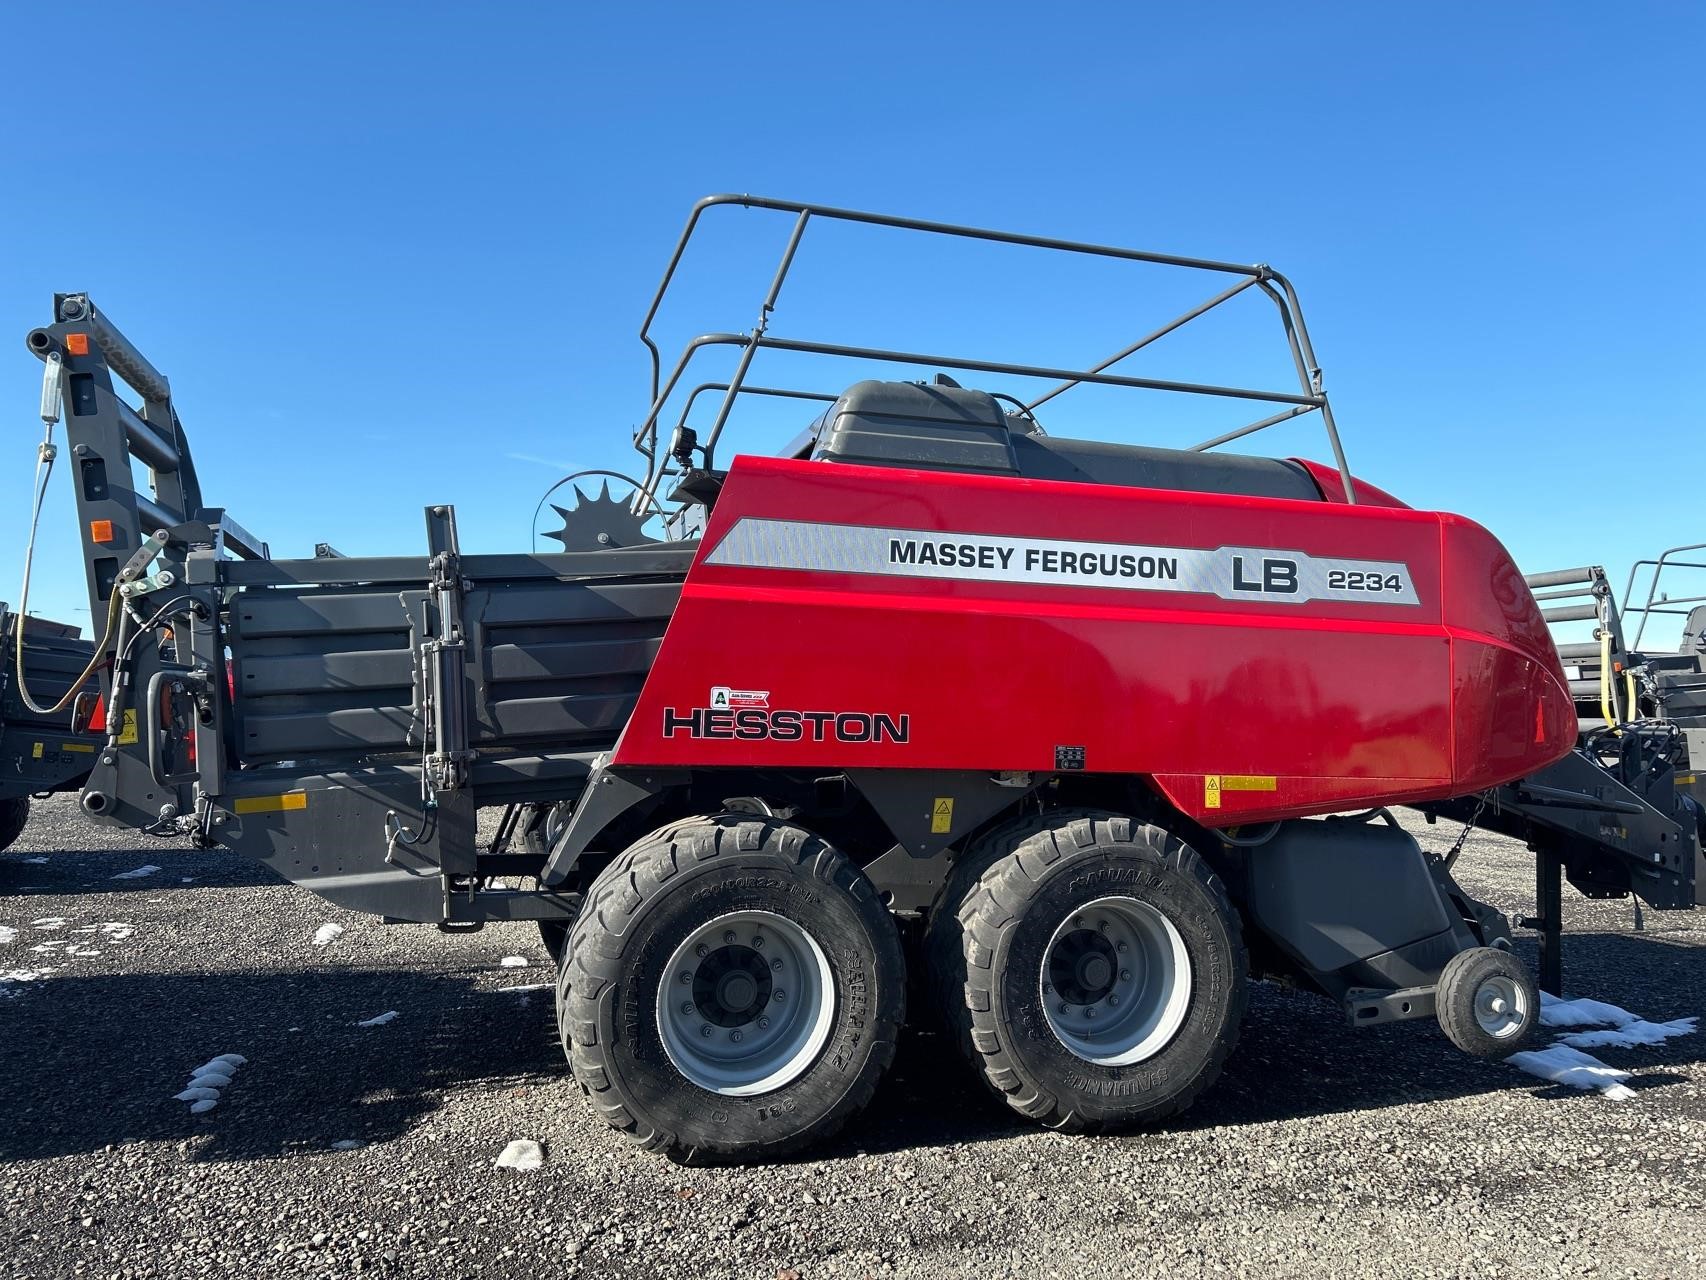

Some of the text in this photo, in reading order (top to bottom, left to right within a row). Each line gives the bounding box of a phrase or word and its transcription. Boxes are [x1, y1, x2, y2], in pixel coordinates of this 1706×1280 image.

[889, 539, 1178, 580] MASSEY FERGUSON
[1232, 556, 1402, 594] LB 2234
[663, 707, 909, 743] HESSTON
